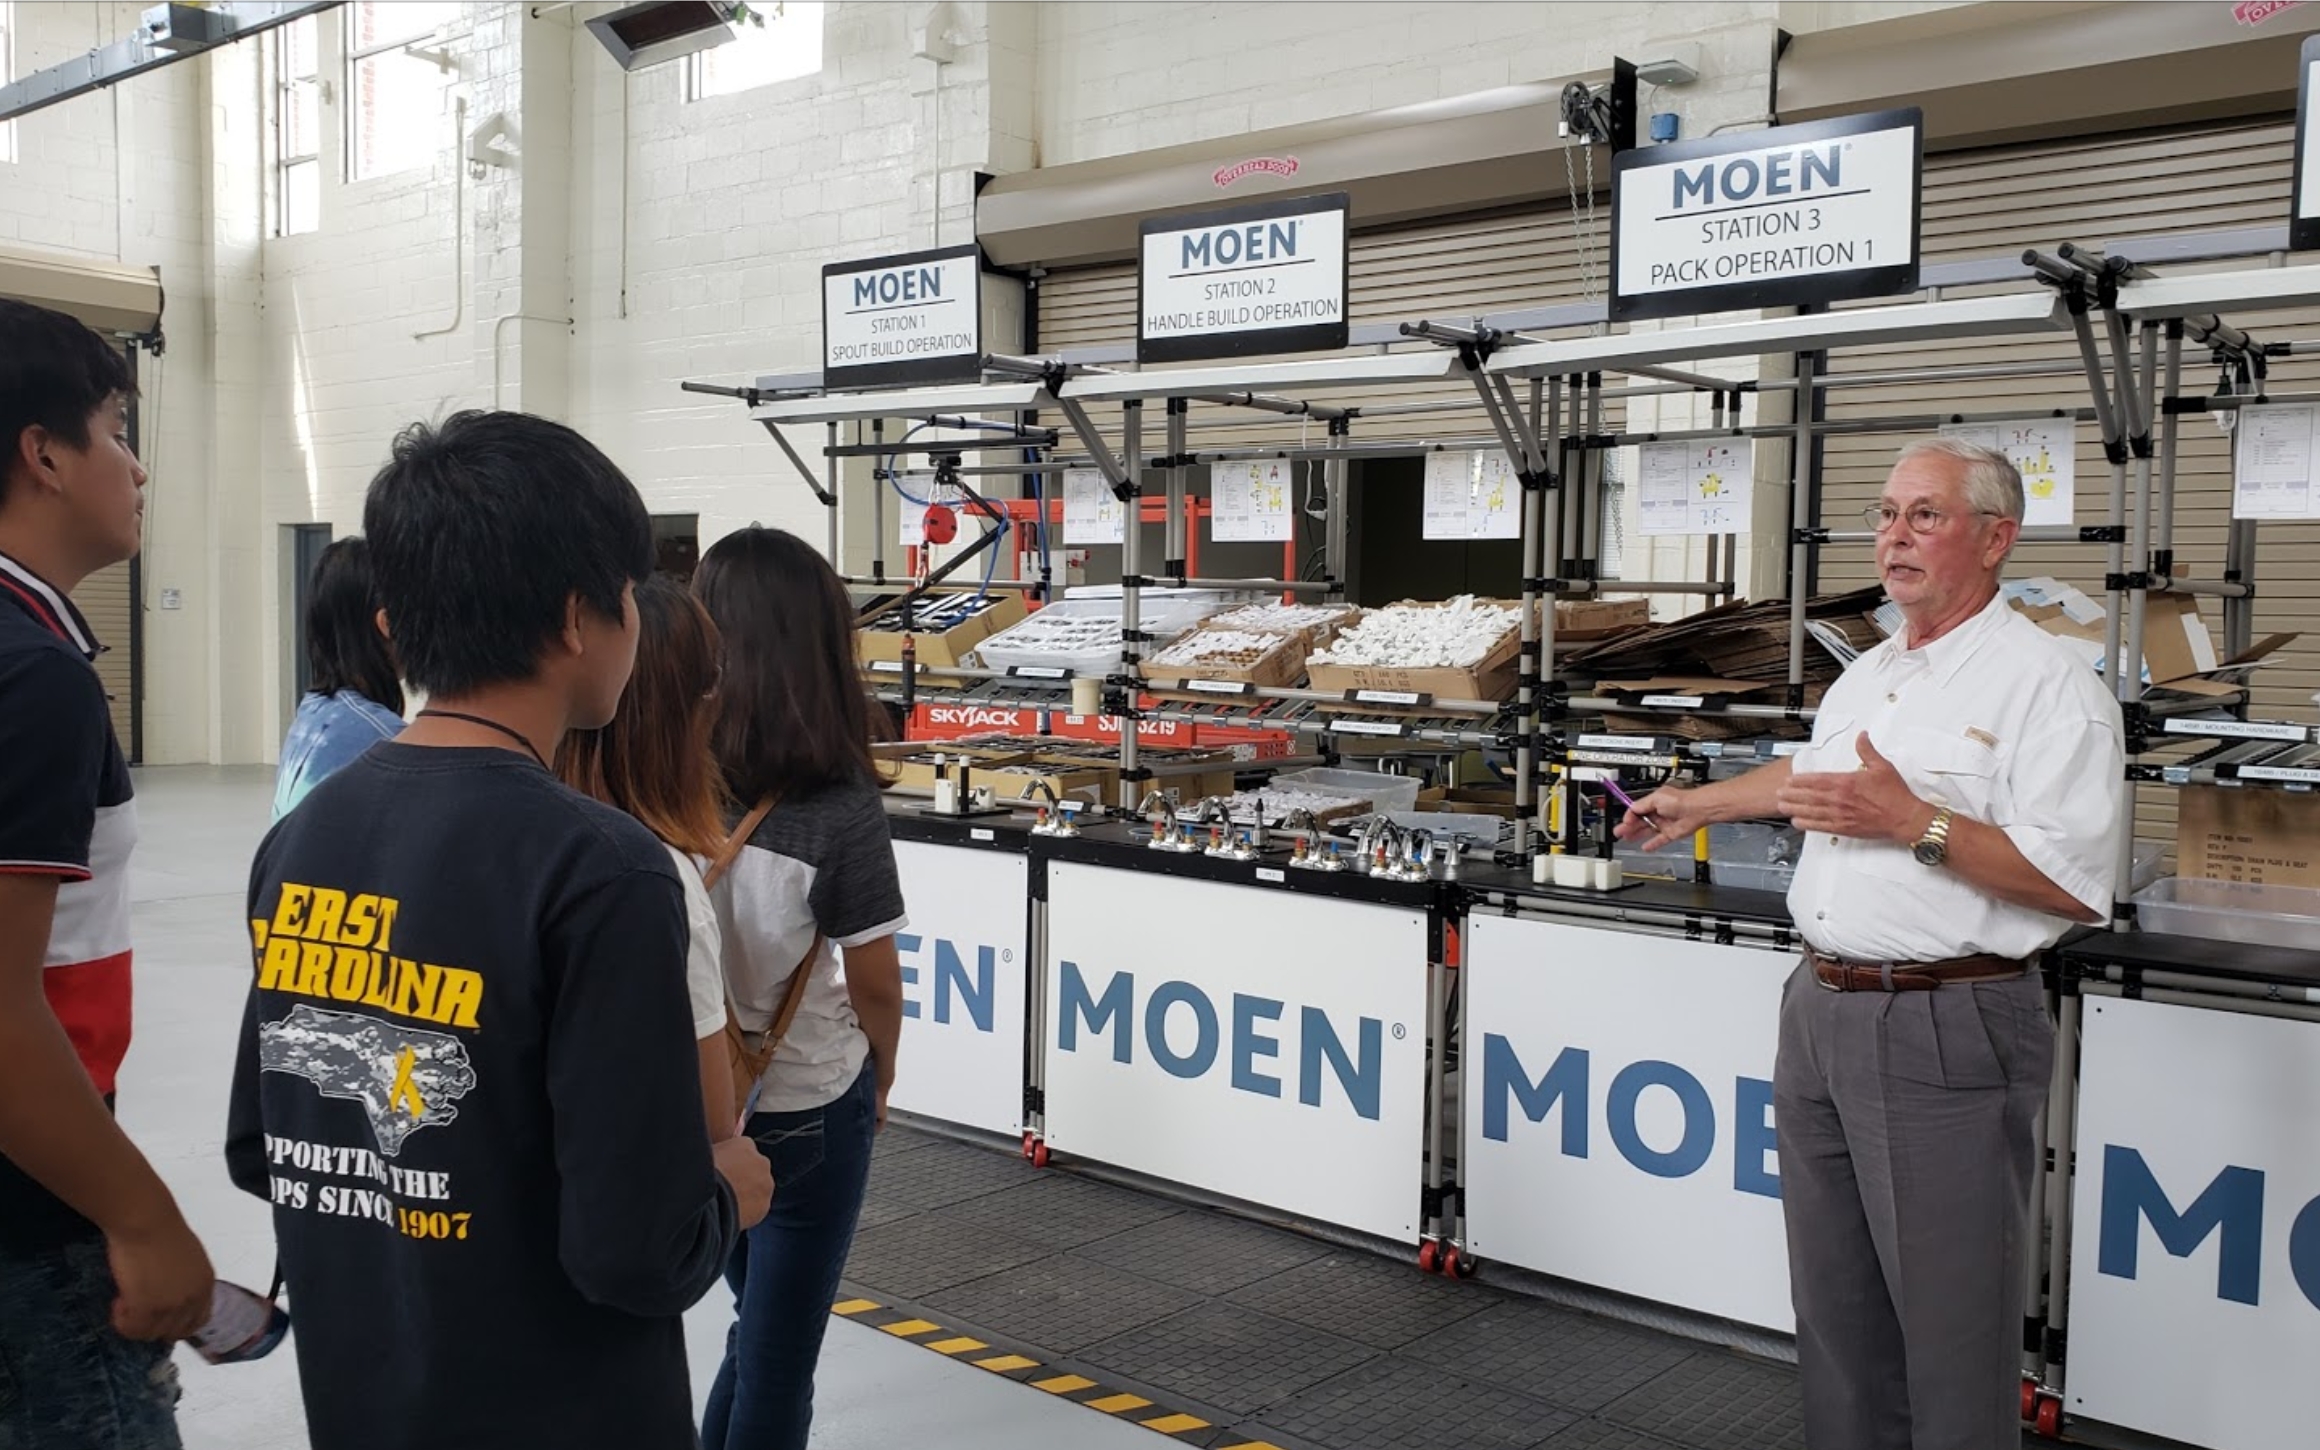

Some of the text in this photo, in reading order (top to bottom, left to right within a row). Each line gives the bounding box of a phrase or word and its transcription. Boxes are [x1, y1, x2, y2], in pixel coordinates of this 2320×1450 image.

[1222, 161, 1289, 183] OVERHEAD DOOR
[1701, 208, 1821, 243] STATION 3
[1651, 239, 1873, 285] PACK OPERATION 1
[1204, 278, 1276, 300] STATION 2
[871, 315, 926, 334] STATION 1
[1148, 298, 1338, 332] HANDLE BUILD OPERATION
[833, 333, 972, 361] SPOUT BUILD OPERATION
[930, 706, 1020, 728] SKYJACK
[1137, 720, 1176, 735] 3219
[2204, 723, 2245, 733] MOUNTING
[2246, 725, 2290, 736] HARDWARE
[1573, 750, 1671, 764] ONE OPERATOR ZONE
[271, 882, 399, 952] EAST
[388, 1164, 450, 1200] THE
[398, 1207, 473, 1240] 1907
[2098, 1143, 2320, 1311] M
